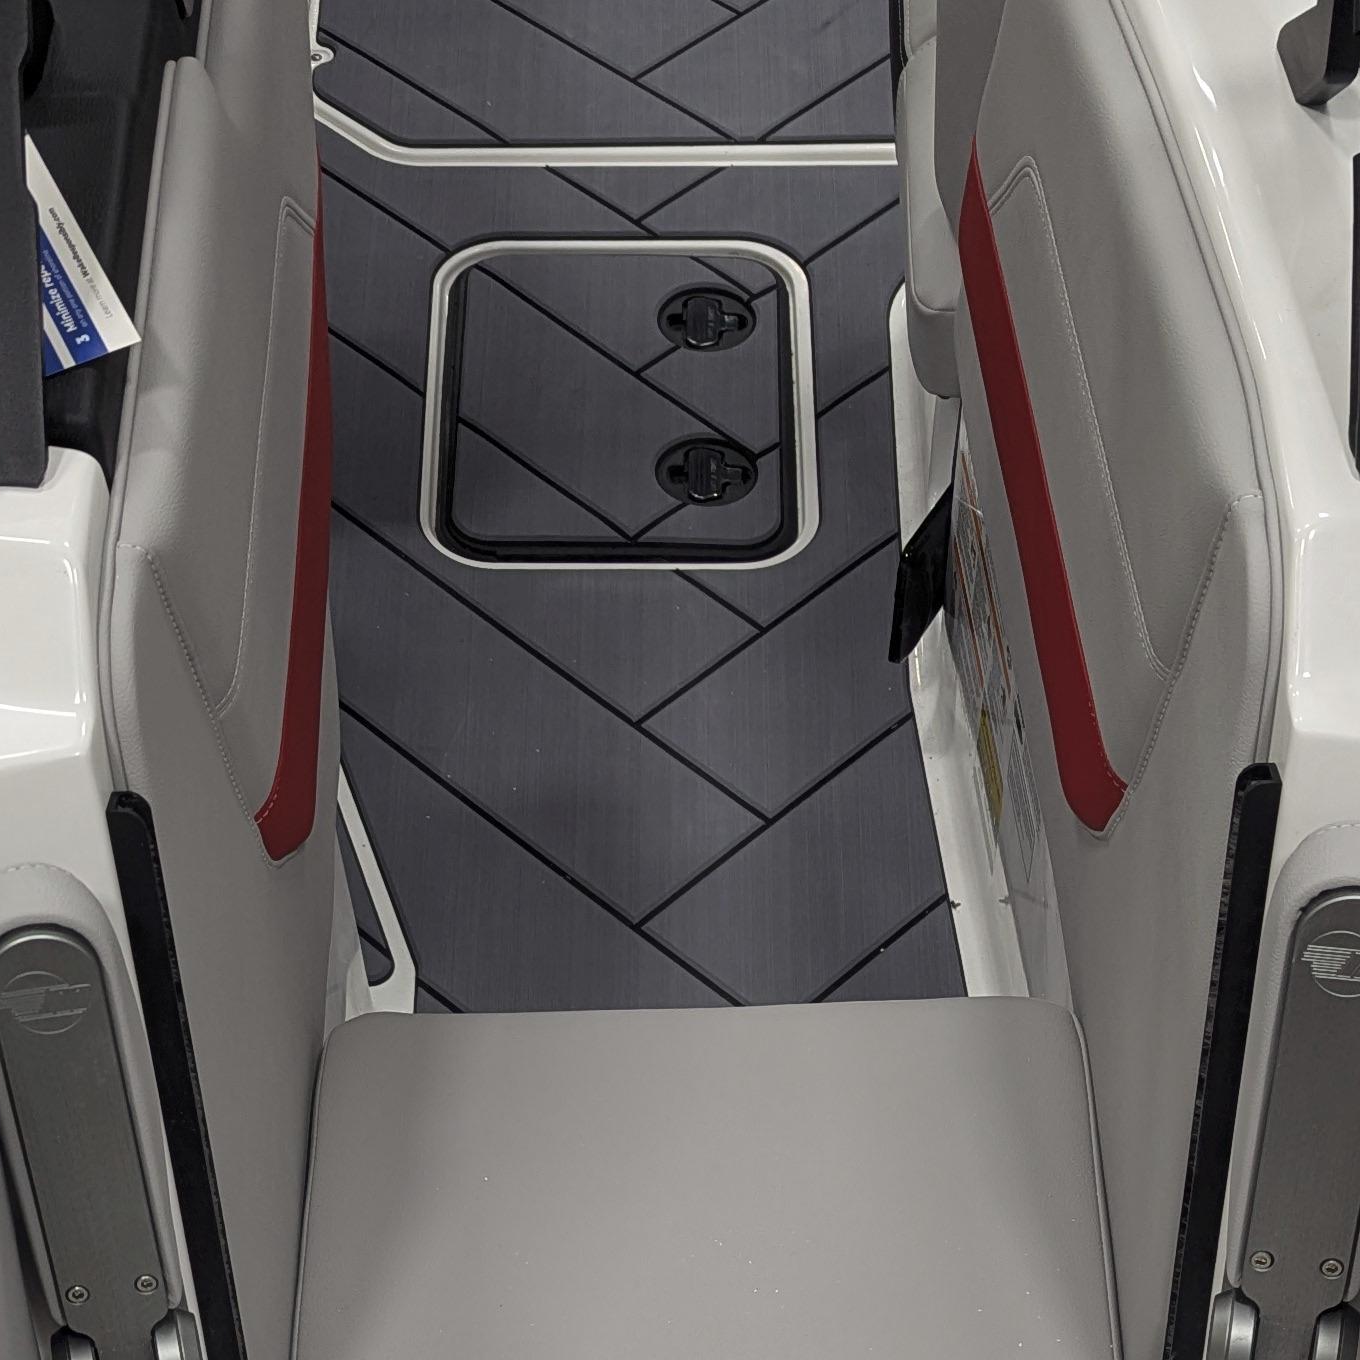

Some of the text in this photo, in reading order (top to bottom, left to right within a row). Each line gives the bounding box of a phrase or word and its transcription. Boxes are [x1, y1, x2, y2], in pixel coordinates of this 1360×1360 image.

[90, 284, 101, 301] more
[48, 288, 78, 333] Minimize
[98, 300, 113, 319] Learn
[75, 334, 90, 345] 3
